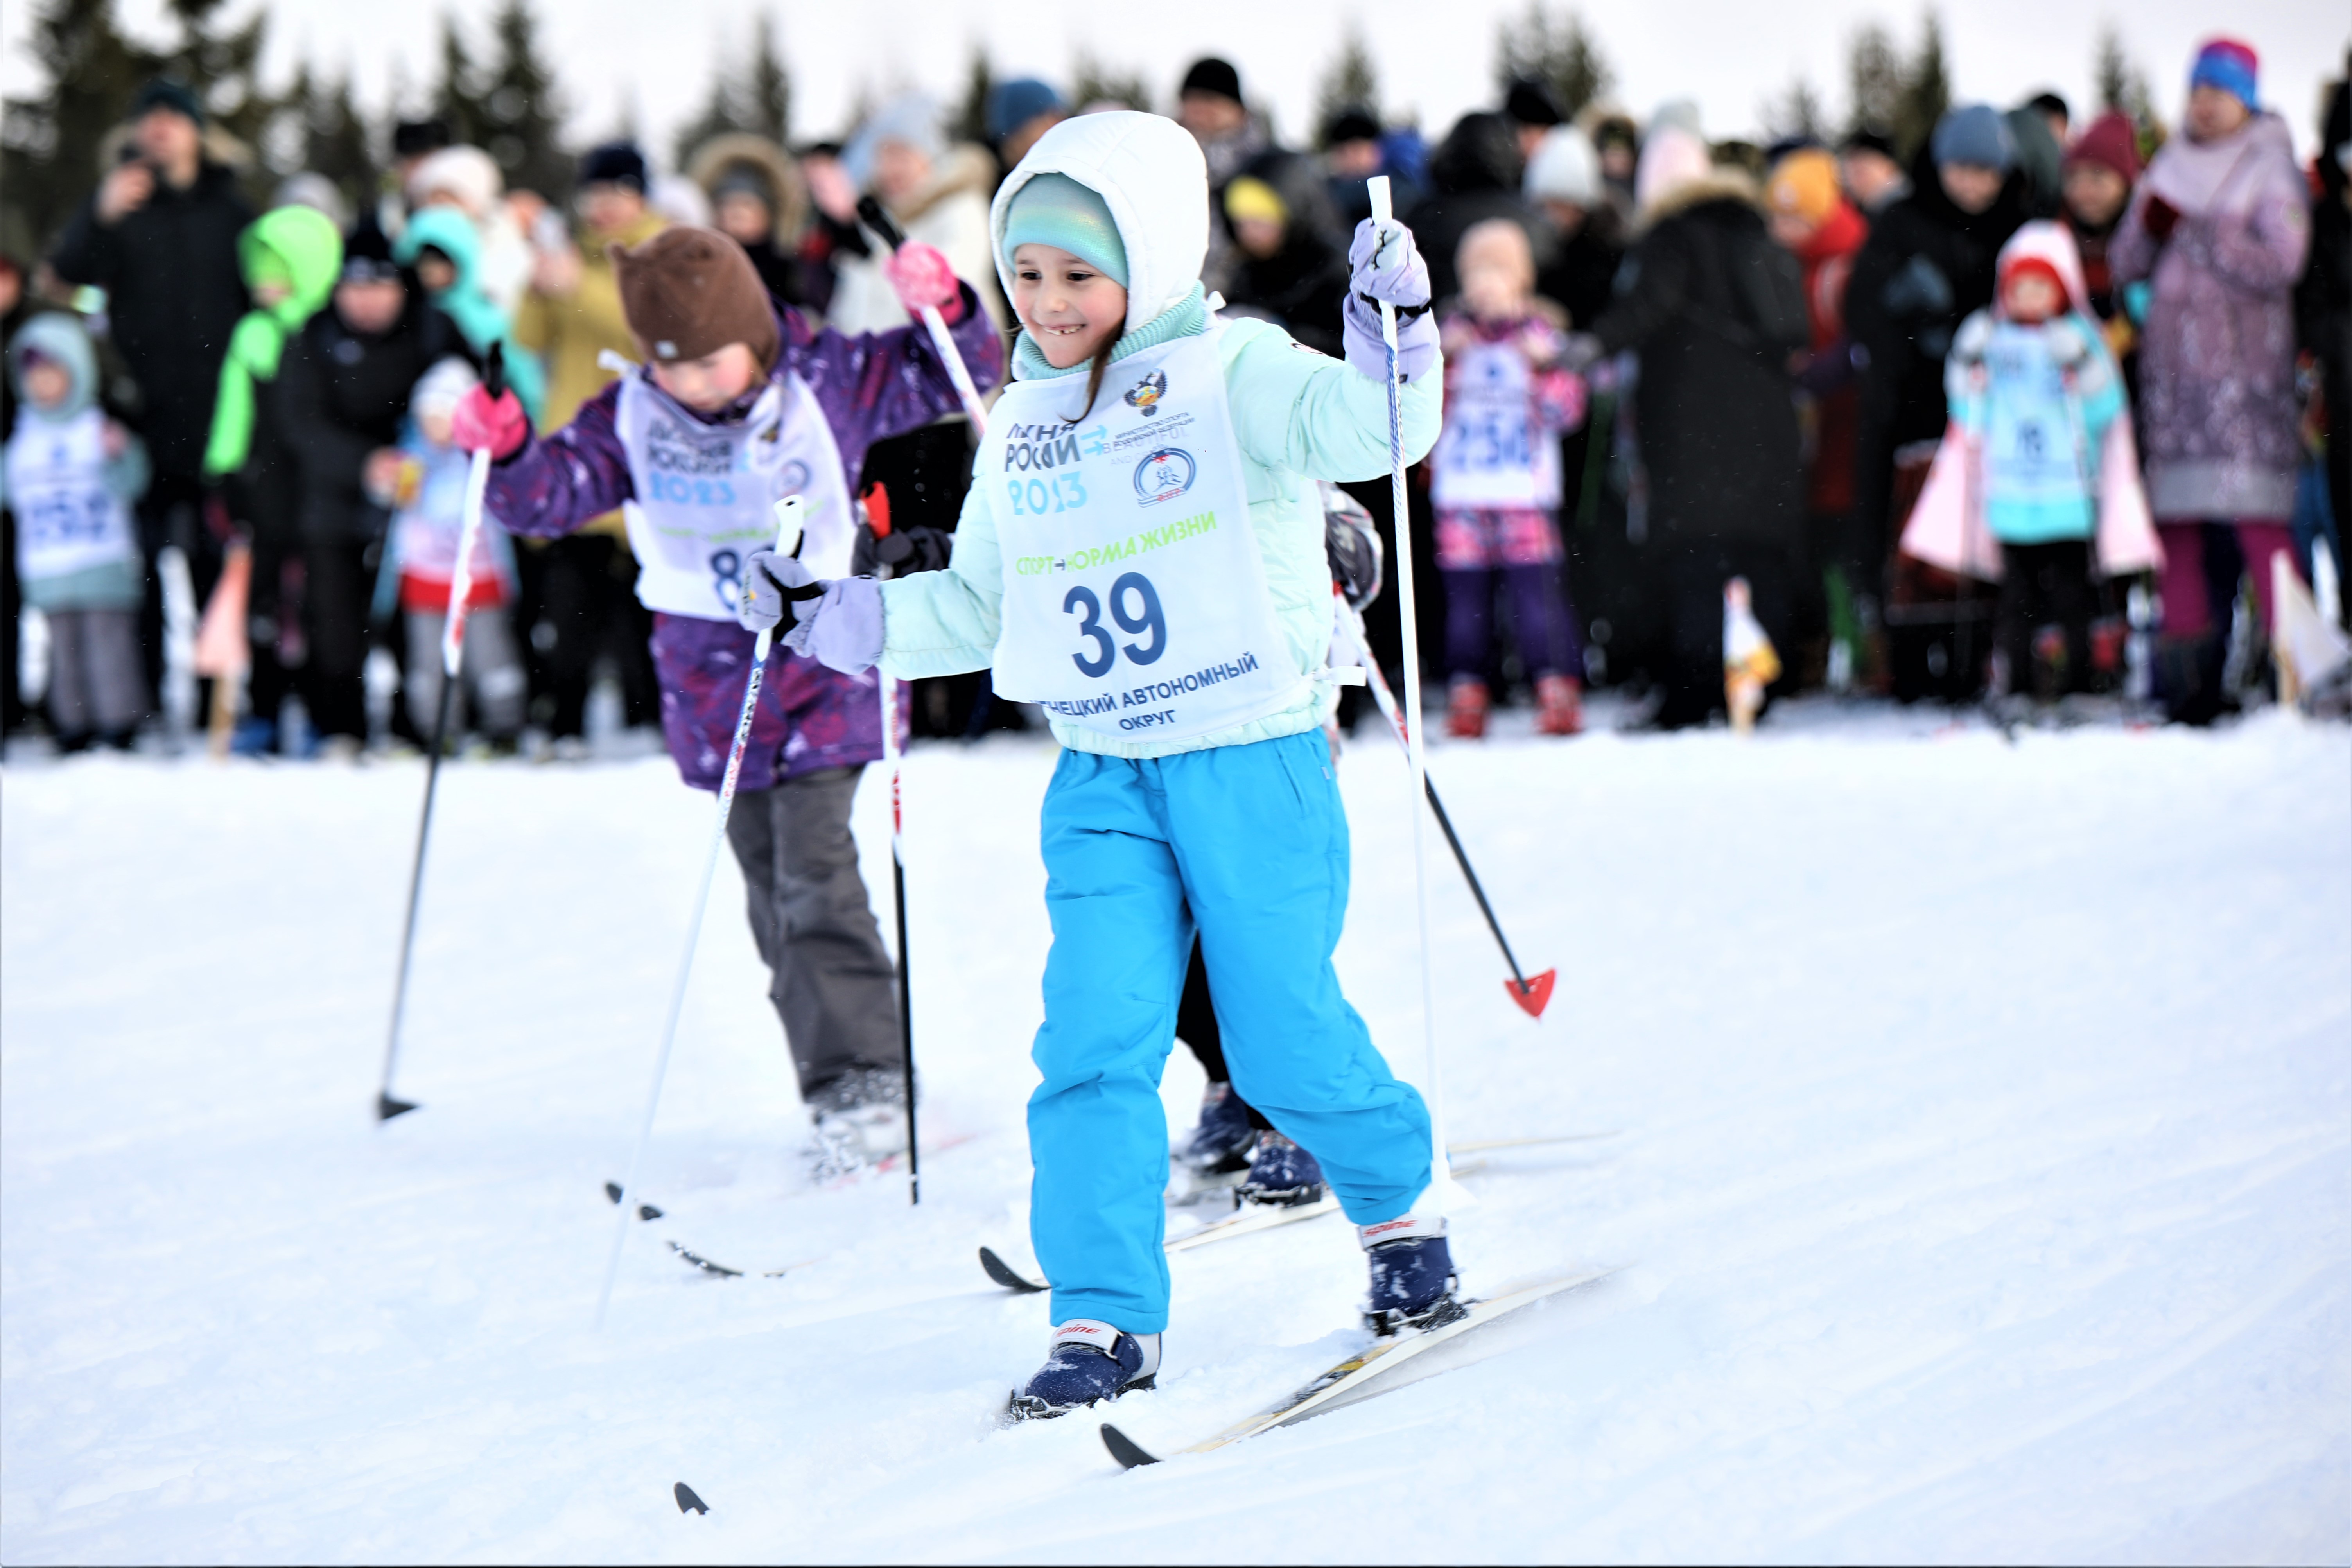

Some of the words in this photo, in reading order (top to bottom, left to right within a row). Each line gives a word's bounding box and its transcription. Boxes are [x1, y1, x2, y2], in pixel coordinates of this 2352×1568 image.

[1065, 536, 1137, 573] НОРМА
[1137, 510, 1218, 553] ЖИЗНИ
[1062, 571, 1168, 678] 39
[1029, 693, 1118, 718] НЕЦКИЙ
[1121, 651, 1259, 708] АВТОНОМНЫЙ
[1118, 709, 1176, 730] ОКРУГ
[1057, 1324, 1102, 1337] pine
